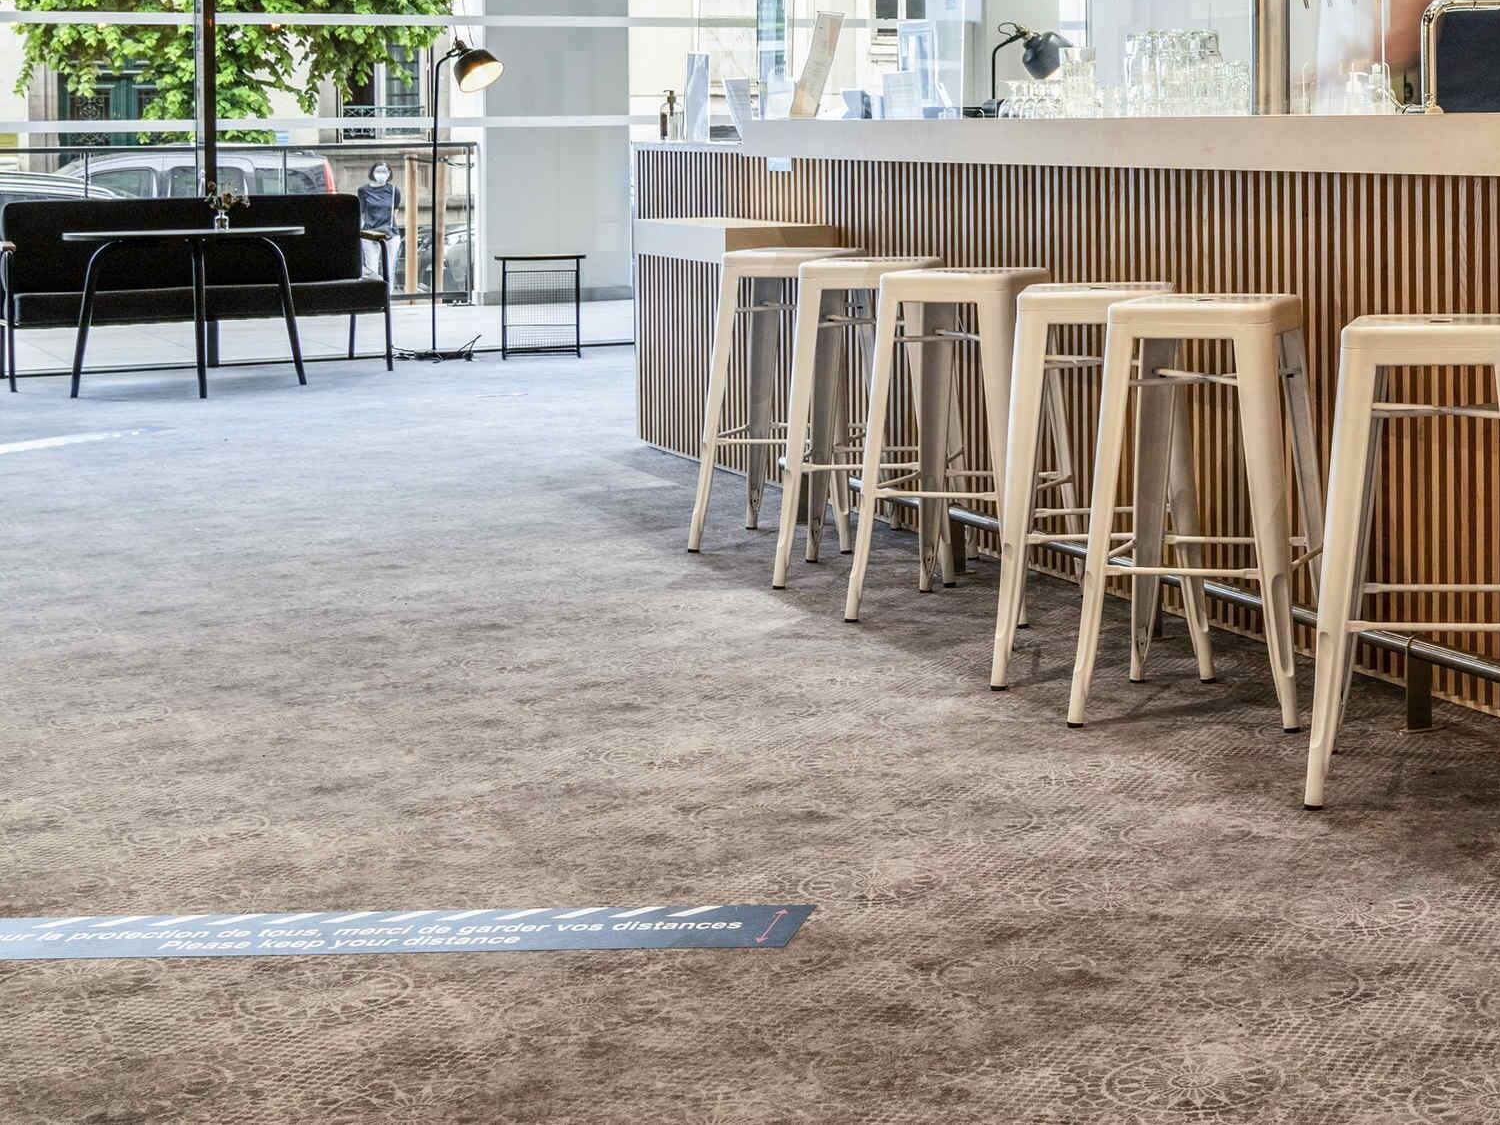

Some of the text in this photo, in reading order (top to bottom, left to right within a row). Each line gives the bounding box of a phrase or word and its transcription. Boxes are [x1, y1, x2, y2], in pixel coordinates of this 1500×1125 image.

[39, 930, 64, 941] la
[65, 928, 210, 943] protection
[217, 928, 251, 939] de
[258, 926, 323, 938] tous,
[335, 925, 411, 936] merci
[418, 924, 451, 935] de
[457, 922, 548, 936] garder
[557, 922, 603, 932] vos
[612, 920, 743, 931] distances
[157, 934, 521, 950] Please keep your distance
